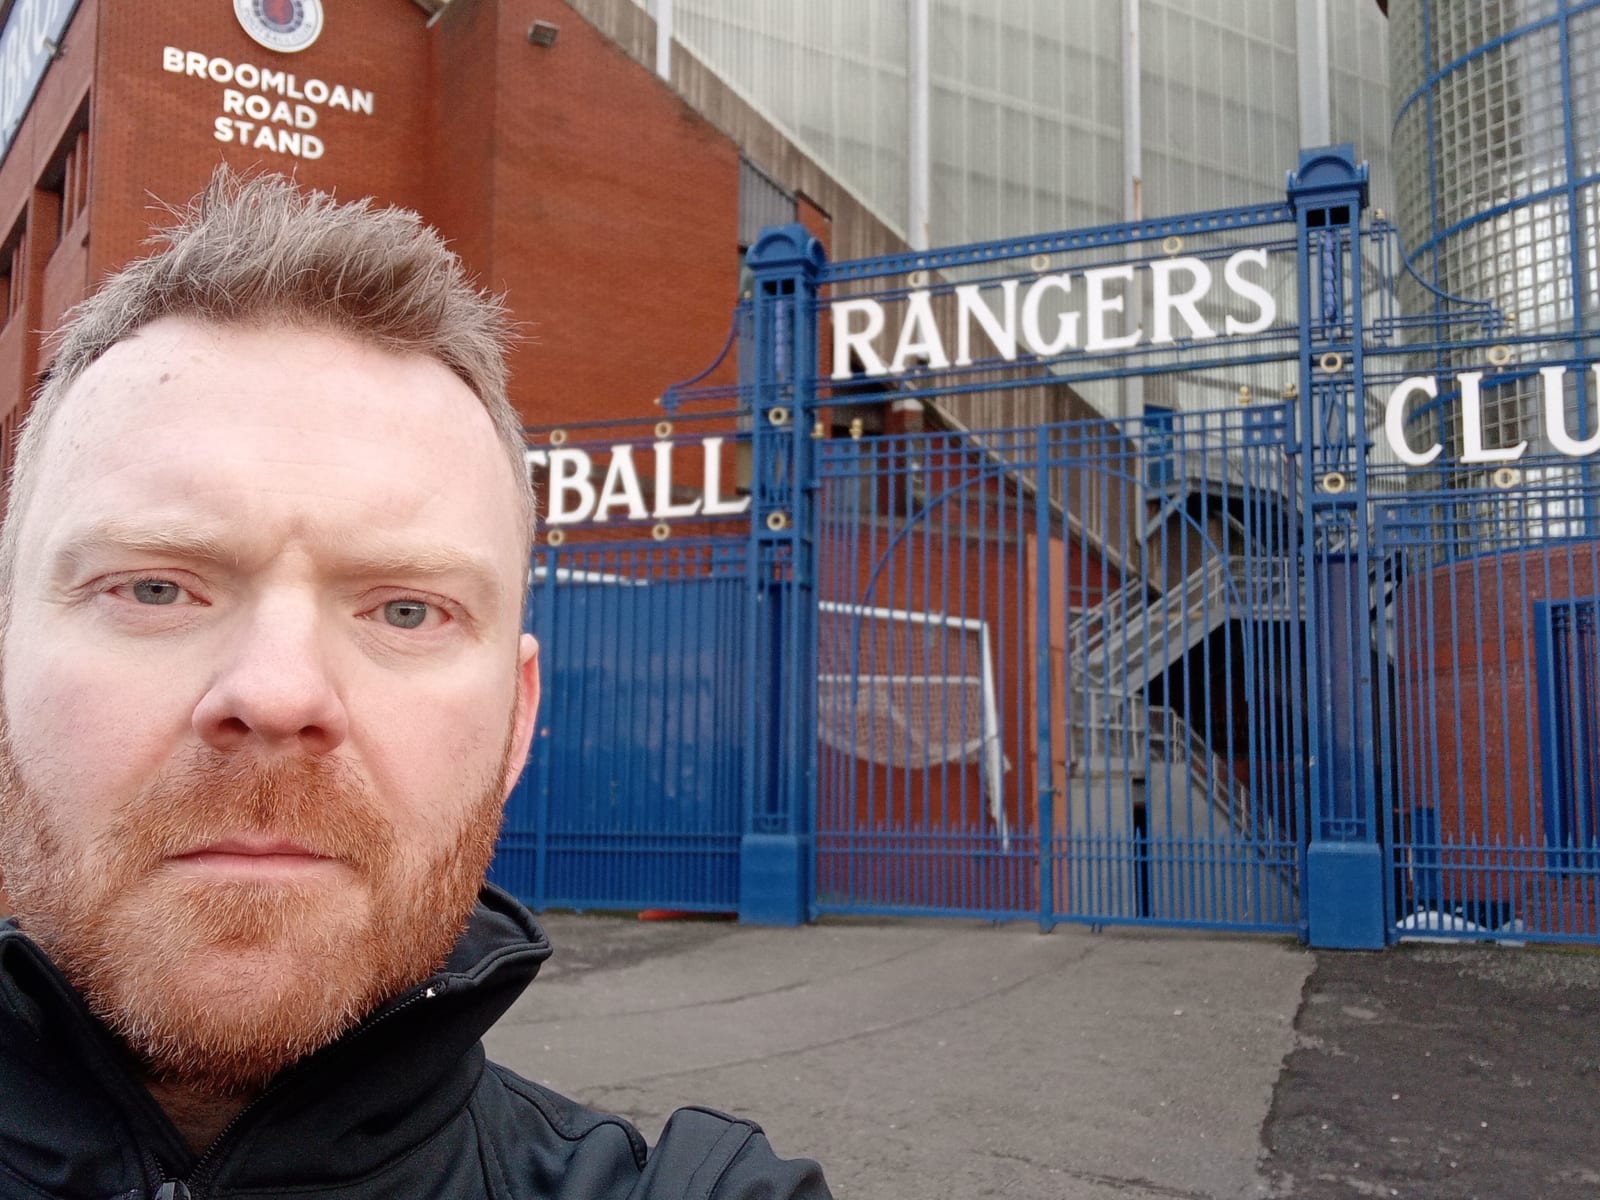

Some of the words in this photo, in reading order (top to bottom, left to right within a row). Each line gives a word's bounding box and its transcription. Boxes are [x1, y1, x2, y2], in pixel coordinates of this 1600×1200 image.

[163, 46, 374, 115] BROOMLOAN
[223, 88, 317, 130] ROAD
[213, 117, 324, 160] STAND
[831, 248, 1278, 379] RANGERS
[1384, 363, 1600, 466] CLU
